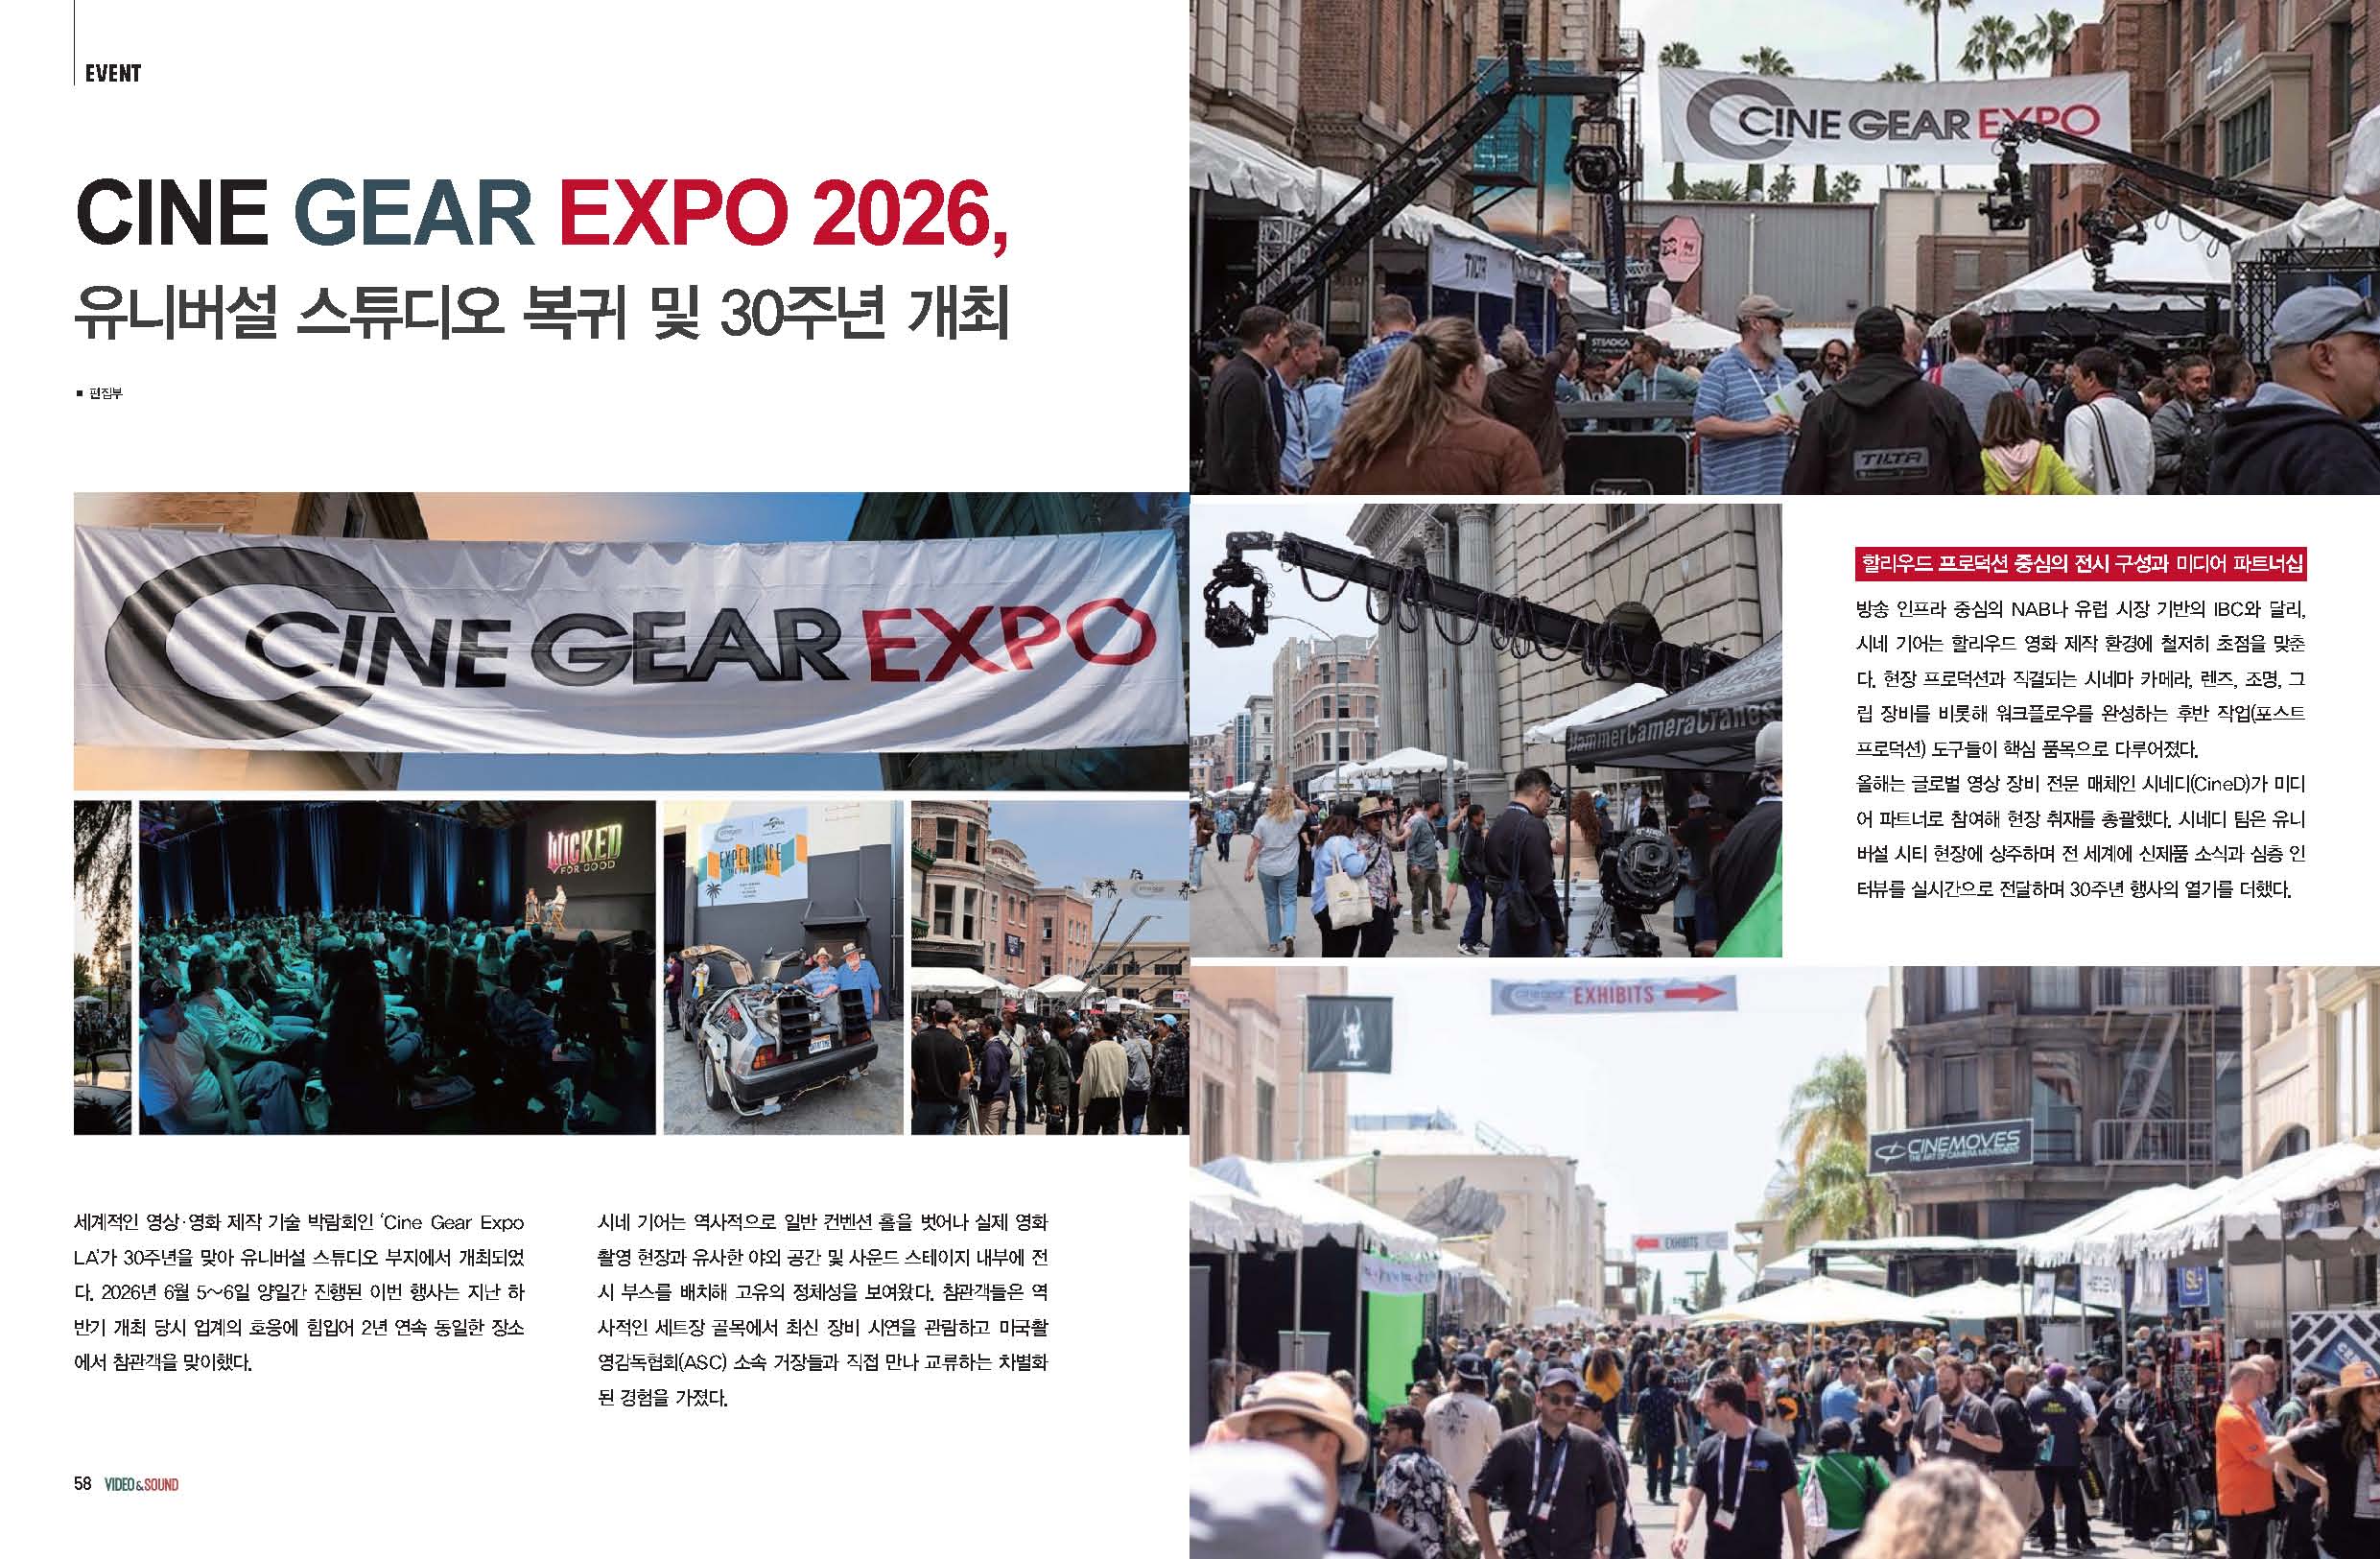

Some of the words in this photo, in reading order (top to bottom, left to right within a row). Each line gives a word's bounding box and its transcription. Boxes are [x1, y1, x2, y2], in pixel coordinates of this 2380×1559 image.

[85, 63, 142, 83] EVENT
[1849, 108, 1970, 141] GEAR
[77, 177, 269, 246] CINE
[295, 177, 536, 247] GEAR
[561, 177, 789, 247] EXPO
[813, 178, 1007, 259] 2026,
[74, 284, 277, 341] 유니버설
[296, 284, 506, 341] 스튜디오
[523, 284, 625, 341] 복귀
[651, 284, 701, 341] 및
[720, 284, 885, 341] 30주년
[907, 284, 1008, 341] 개최
[1591, 337, 1631, 347] STEADICA
[89, 387, 124, 400] 편집부
[1862, 554, 1934, 574] 할리우드
[1938, 554, 2009, 574] 프로덕션
[2014, 554, 2068, 574] 중심의
[2074, 554, 2109, 574] 전시
[2114, 554, 2170, 574] 구성과
[2177, 554, 2227, 574] 미디어
[2233, 554, 2303, 574] 파트너십
[1856, 600, 1890, 619] 방송
[1897, 600, 1947, 619] 인프라
[1953, 600, 2003, 619] 중심의
[2012, 600, 2069, 619] NAB나
[2074, 600, 2108, 619] 유럽
[2115, 600, 2151, 619] 시장
[2156, 600, 2205, 619] 기반의
[2214, 600, 2262, 619] IBC와
[2270, 600, 2306, 620] 달리,
[530, 606, 850, 688] GEAR
[861, 597, 1158, 683] EXPO
[1855, 634, 1888, 653] 시네
[1896, 634, 1944, 653] 기어는
[1951, 634, 2017, 653] 할리우드
[2024, 634, 2059, 653] 영화
[2063, 634, 2099, 653] 제작
[2105, 634, 2153, 653] 환경에
[2160, 634, 2209, 653] 철저히
[2216, 634, 2267, 653] 초점을
[2274, 634, 2306, 653] 맞춘
[1857, 670, 1876, 689] 다.
[1883, 670, 1918, 689] 현장
[1922, 670, 2007, 689] 프로덕션과
[2013, 670, 2078, 689] 직결되는
[2084, 670, 2134, 689] 시네마
[2140, 670, 2193, 690] 카메라,
[2201, 670, 2238, 690] 렌즈,
[2245, 670, 2282, 690] 조명,
[2288, 672, 2306, 686] 그
[1855, 739, 1926, 760] 프로덕션)
[1931, 740, 1997, 759] 도구들이
[2003, 740, 2036, 759] 핵심
[2041, 740, 2109, 759] 품목으로
[2115, 740, 2199, 759] 다루어졌다.
[1855, 774, 1906, 793] 올해는
[1911, 774, 1960, 793] 글로벌
[1967, 774, 2001, 793] 영상
[2006, 774, 2039, 793] 장비
[2046, 774, 2080, 792] 전문
[2087, 774, 2136, 793] 매체인
[2141, 773, 2269, 794] 시네디(CineD)가
[2274, 774, 2305, 793] 미디
[547, 823, 623, 875] WICKED
[719, 842, 782, 869] EXPERIENCE
[560, 865, 580, 876] FOR
[583, 861, 616, 873] GOOD
[1857, 880, 1906, 899] 터뷰를
[1911, 880, 1994, 899] 실시간으로
[1999, 880, 2064, 899] 전달하며
[2069, 880, 2124, 899] 30주년
[2130, 880, 2179, 899] 행사의
[2184, 880, 2234, 899] 열기를
[2240, 880, 2292, 899] 더했다.
[1573, 985, 1655, 1005] EXHIBITS
[1907, 1129, 2021, 1155] CINEMOVES
[73, 1213, 139, 1232] 세계적인
[226, 1213, 263, 1232] 제작
[268, 1213, 301, 1232] 기술
[308, 1213, 374, 1232] 박람회인
[431, 1214, 473, 1231] Gear
[481, 1215, 525, 1233] Expo
[597, 1213, 630, 1232] 시네
[637, 1213, 687, 1232] 기어는
[694, 1213, 777, 1232] 역사적으로
[784, 1213, 818, 1232] 일반
[823, 1213, 873, 1231] 컨벤션
[878, 1213, 913, 1232] 홀을
[921, 1213, 970, 1232] 벗어나
[975, 1213, 1008, 1232] 실제
[1015, 1213, 1049, 1232] 영화
[123, 1248, 194, 1267] 30주년을
[200, 1248, 235, 1267] 맞아
[240, 1248, 306, 1267] 유니버설
[312, 1248, 379, 1267] 스튜디오
[385, 1248, 451, 1267] 부지에서
[459, 1248, 525, 1267] 개최되었
[597, 1248, 631, 1267] 촬영
[637, 1248, 688, 1267] 현장과
[692, 1248, 744, 1267] 유사한
[748, 1248, 781, 1267] 야외
[787, 1248, 822, 1267] 공간
[828, 1248, 844, 1267] 및
[848, 1248, 900, 1267] 사운드
[904, 1248, 970, 1267] 스테이지
[977, 1248, 1025, 1267] 내부에
[1031, 1248, 1049, 1266] 전
[75, 1283, 94, 1302] 다.
[101, 1283, 156, 1301] 2026년
[163, 1283, 190, 1302] 6월
[257, 1283, 308, 1302] 양일간
[314, 1283, 363, 1302] 진행된
[369, 1283, 402, 1302] 이번
[410, 1283, 460, 1302] 행사는
[467, 1283, 502, 1302] 지난
[507, 1283, 526, 1302] 하
[74, 1353, 106, 1372] 에서
[112, 1353, 178, 1372] 참관객을
[183, 1353, 252, 1372] 맞이했다.
[598, 1352, 727, 1373] 영감독협회(ASC)
[733, 1353, 767, 1372] 소속
[773, 1353, 840, 1372] 거장들과
[846, 1353, 879, 1372] 직접
[885, 1353, 920, 1372] 만나
[924, 1353, 993, 1372] 교류하는
[999, 1353, 1049, 1372] 차별화
[598, 1388, 615, 1406] 된
[620, 1388, 670, 1407] 경험을
[675, 1388, 728, 1407] 가졌다.
[74, 1476, 92, 1491] 58
